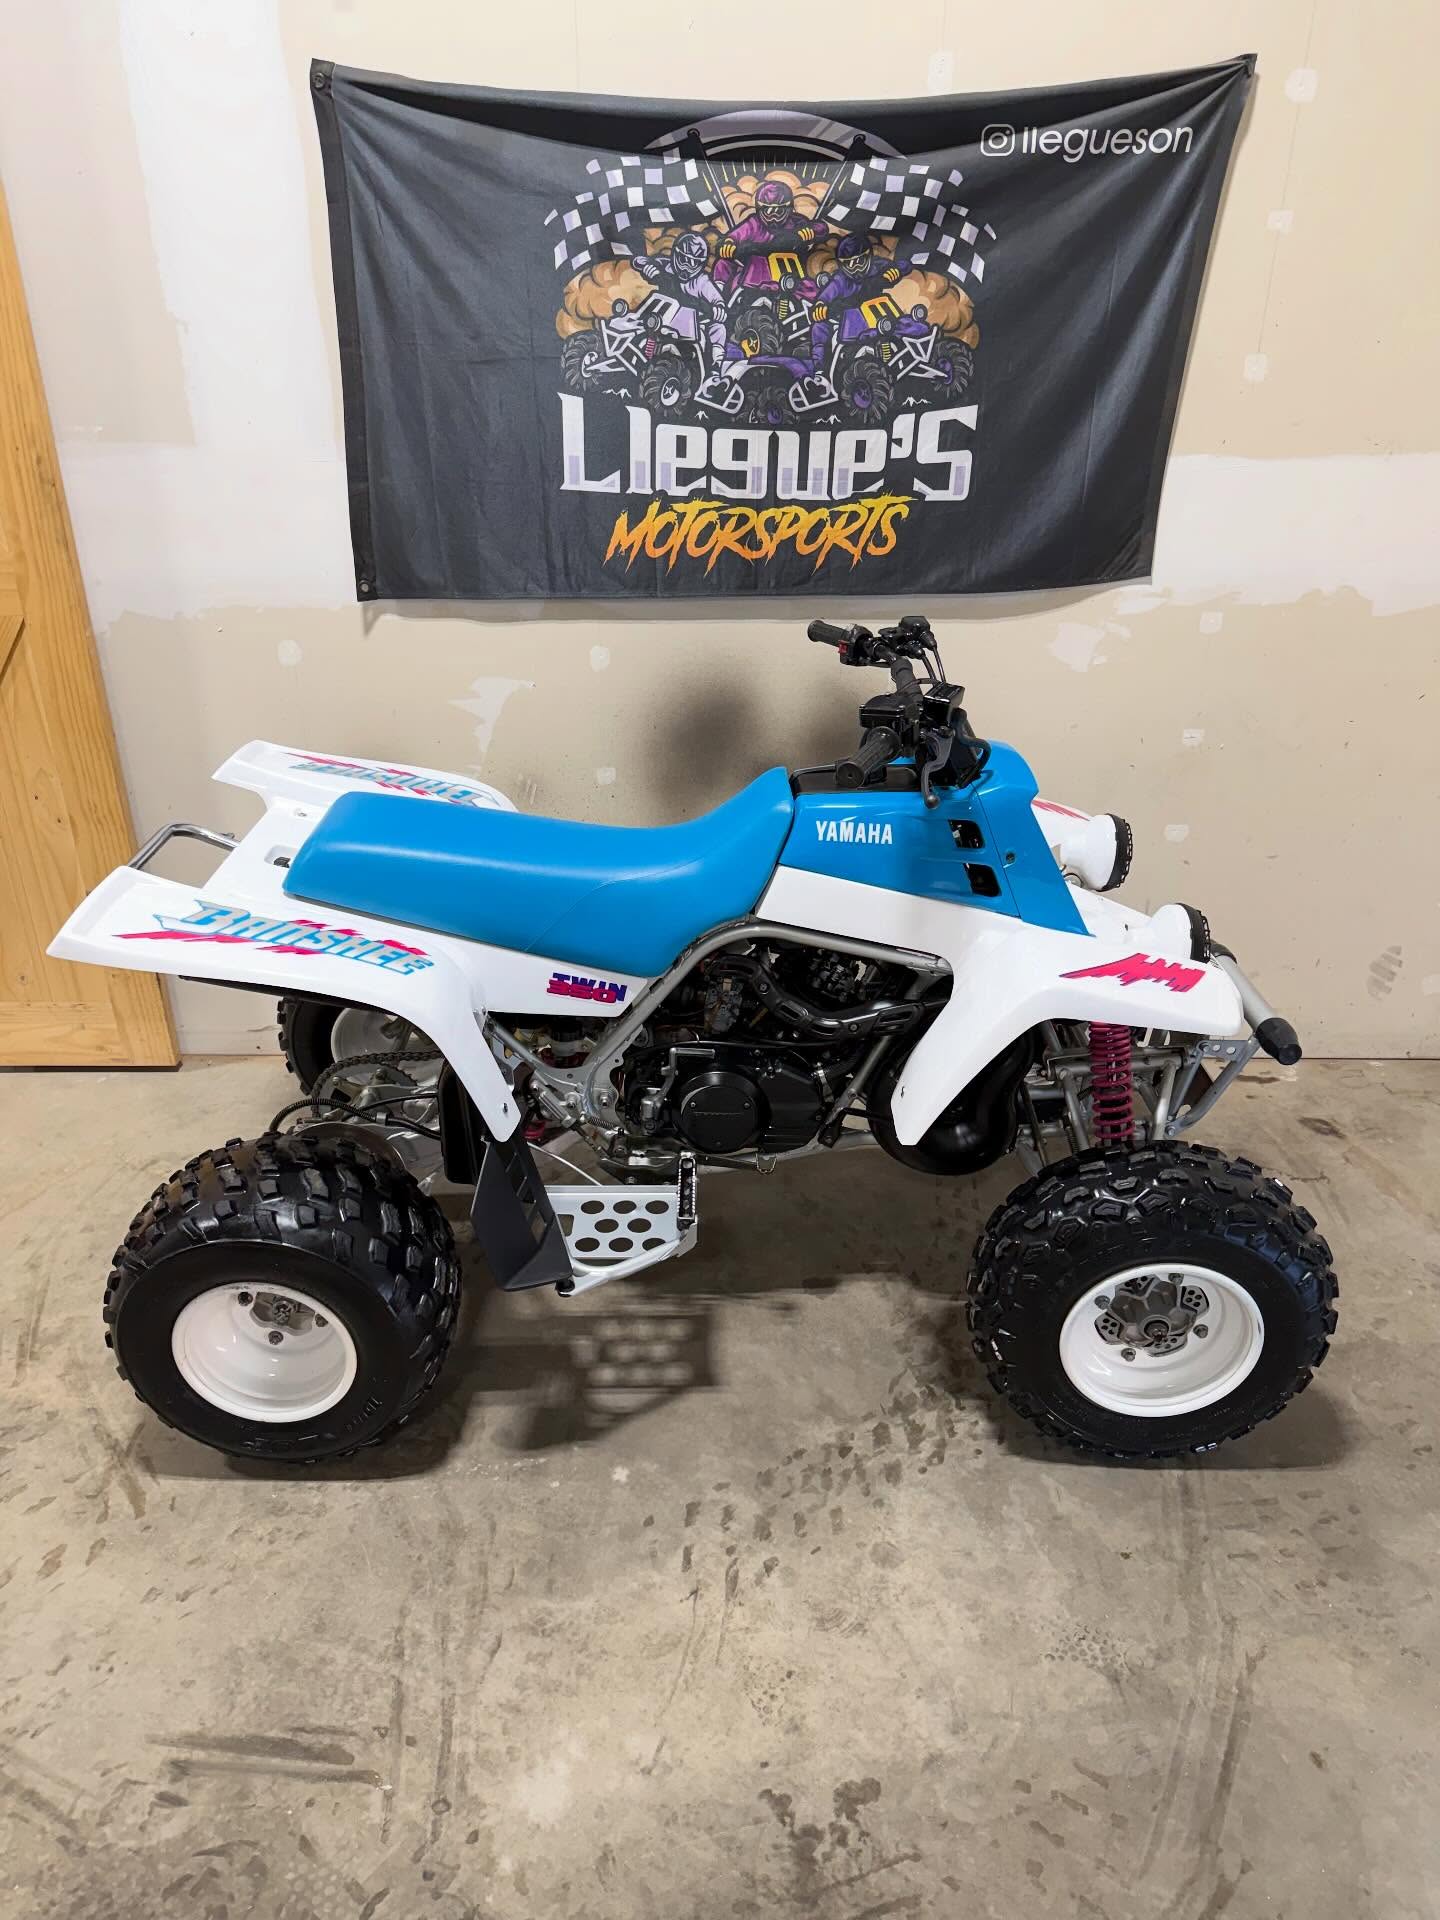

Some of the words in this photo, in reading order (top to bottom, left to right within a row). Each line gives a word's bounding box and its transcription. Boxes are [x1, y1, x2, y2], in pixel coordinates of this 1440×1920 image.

[1022, 126, 1194, 164] llegueson
[602, 491, 918, 577] MOTORSPORTS
[815, 820, 893, 845] YAMAHA
[552, 972, 628, 1002] TWIN
